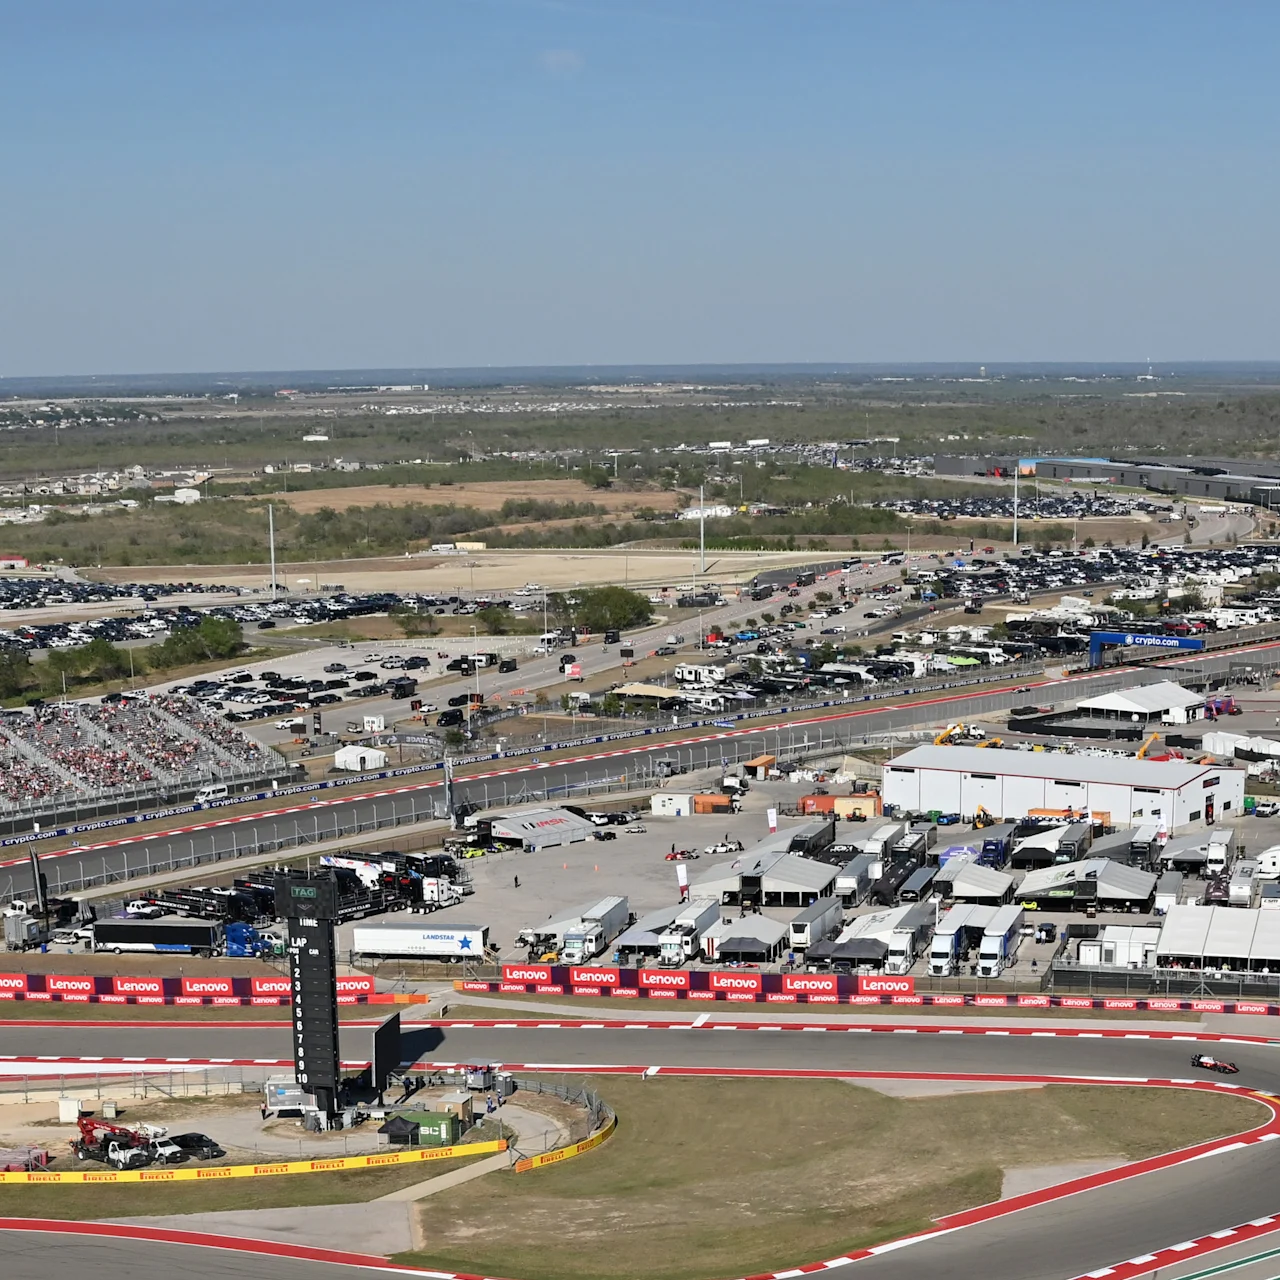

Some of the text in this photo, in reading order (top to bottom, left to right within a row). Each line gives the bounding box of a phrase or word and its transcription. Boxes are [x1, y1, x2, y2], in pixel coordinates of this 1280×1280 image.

[1135, 635, 1179, 647] crypto.com
[559, 738, 596, 749] crypto.com
[275, 783, 320, 797] crypto.com
[146, 806, 194, 820] crypto.com
[5, 830, 57, 846] crypto.com
[294, 888, 313, 897] TAG
[299, 917, 318, 927] TIME
[291, 937, 307, 947] LAP
[295, 955, 299, 964] 1
[295, 968, 300, 977] 2
[507, 969, 547, 979] Lenovo
[574, 971, 615, 982] Lenovo
[643, 973, 685, 984] Lenovo
[714, 976, 757, 988] Lenovo
[50, 979, 90, 989] Lenovo
[118, 981, 159, 991] Lenovo
[187, 982, 228, 991] Lenovo
[256, 981, 292, 993] Lenov
[295, 981, 300, 990] 3
[336, 981, 370, 991] enovo
[787, 979, 832, 989] Lenovo
[863, 980, 908, 990] Lenovo
[296, 995, 301, 1004] 4
[296, 1008, 302, 1017] 5
[1236, 1003, 1264, 1012] Lenovo
[297, 1021, 302, 1030] 6
[298, 1034, 302, 1043] 7
[299, 1048, 303, 1056] 8
[299, 1061, 304, 1070] 9
[297, 1074, 307, 1083] 10
[421, 1149, 453, 1159] PIRELLI
[28, 1173, 61, 1182] PIRELLI
[197, 1168, 231, 1178] PIRELLI
